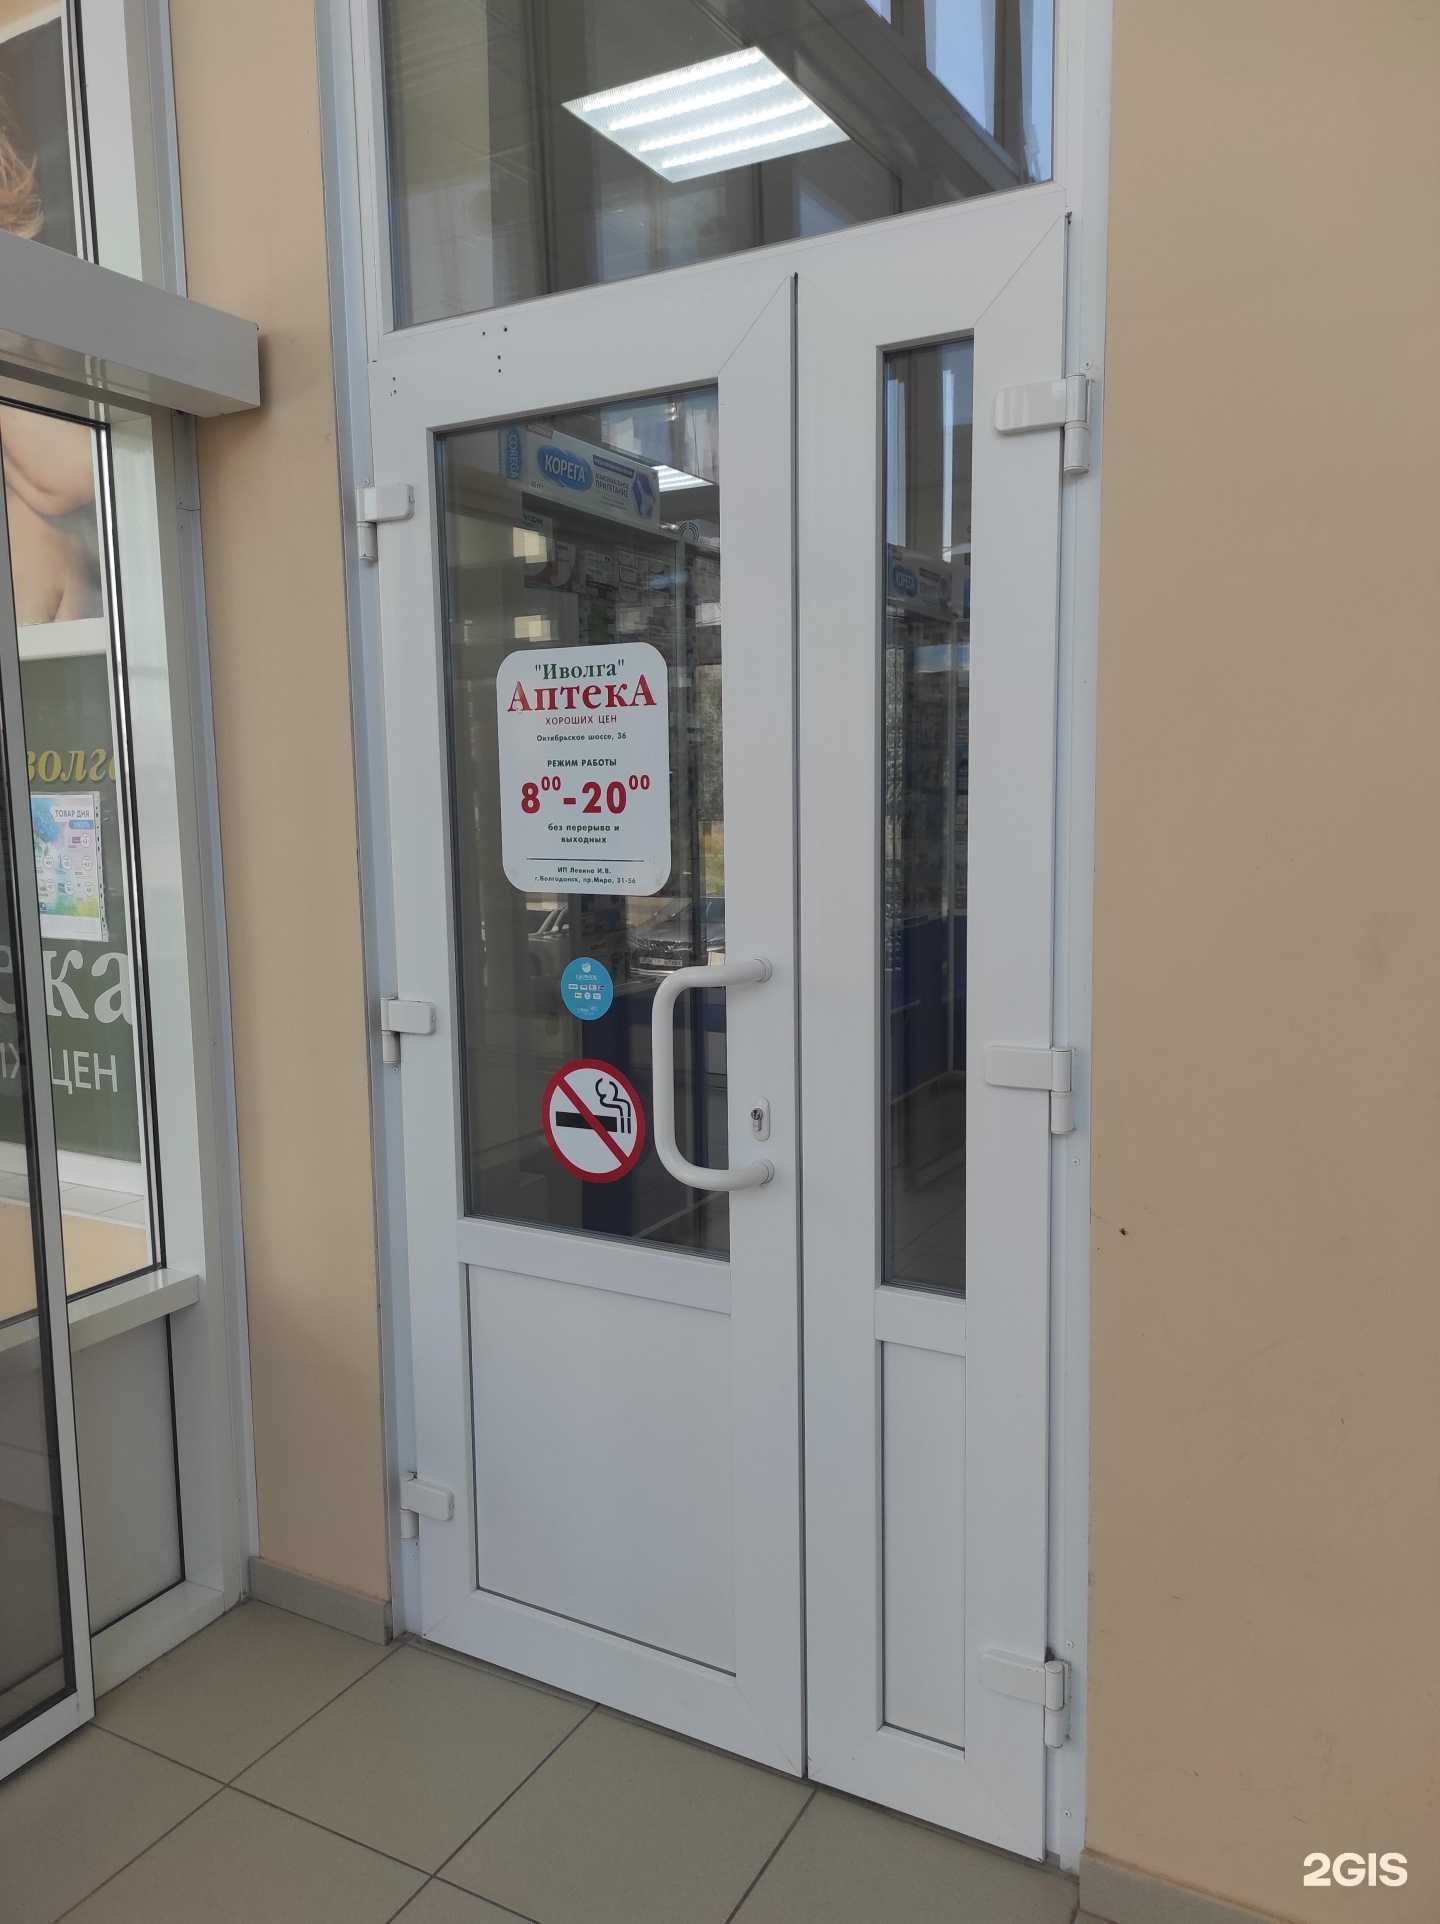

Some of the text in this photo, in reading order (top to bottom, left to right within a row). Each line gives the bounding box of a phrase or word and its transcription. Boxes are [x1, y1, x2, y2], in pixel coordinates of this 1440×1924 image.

[544, 455, 586, 483] КОРЕГА
[535, 659, 625, 680] "Иволга"
[507, 673, 657, 712] АптекА
[545, 714, 617, 726] ХОРОШИХ ЦЕН
[588, 733, 614, 742] шоссе,
[547, 758, 617, 768] РЕЖИМ РАБОТЫ
[54, 809, 91, 819] ТОВАР ДНЯ
[547, 823, 563, 831] без
[566, 824, 611, 833] перерыва
[560, 836, 607, 844] выходных
[49, 1047, 118, 1095] ЦЕН
